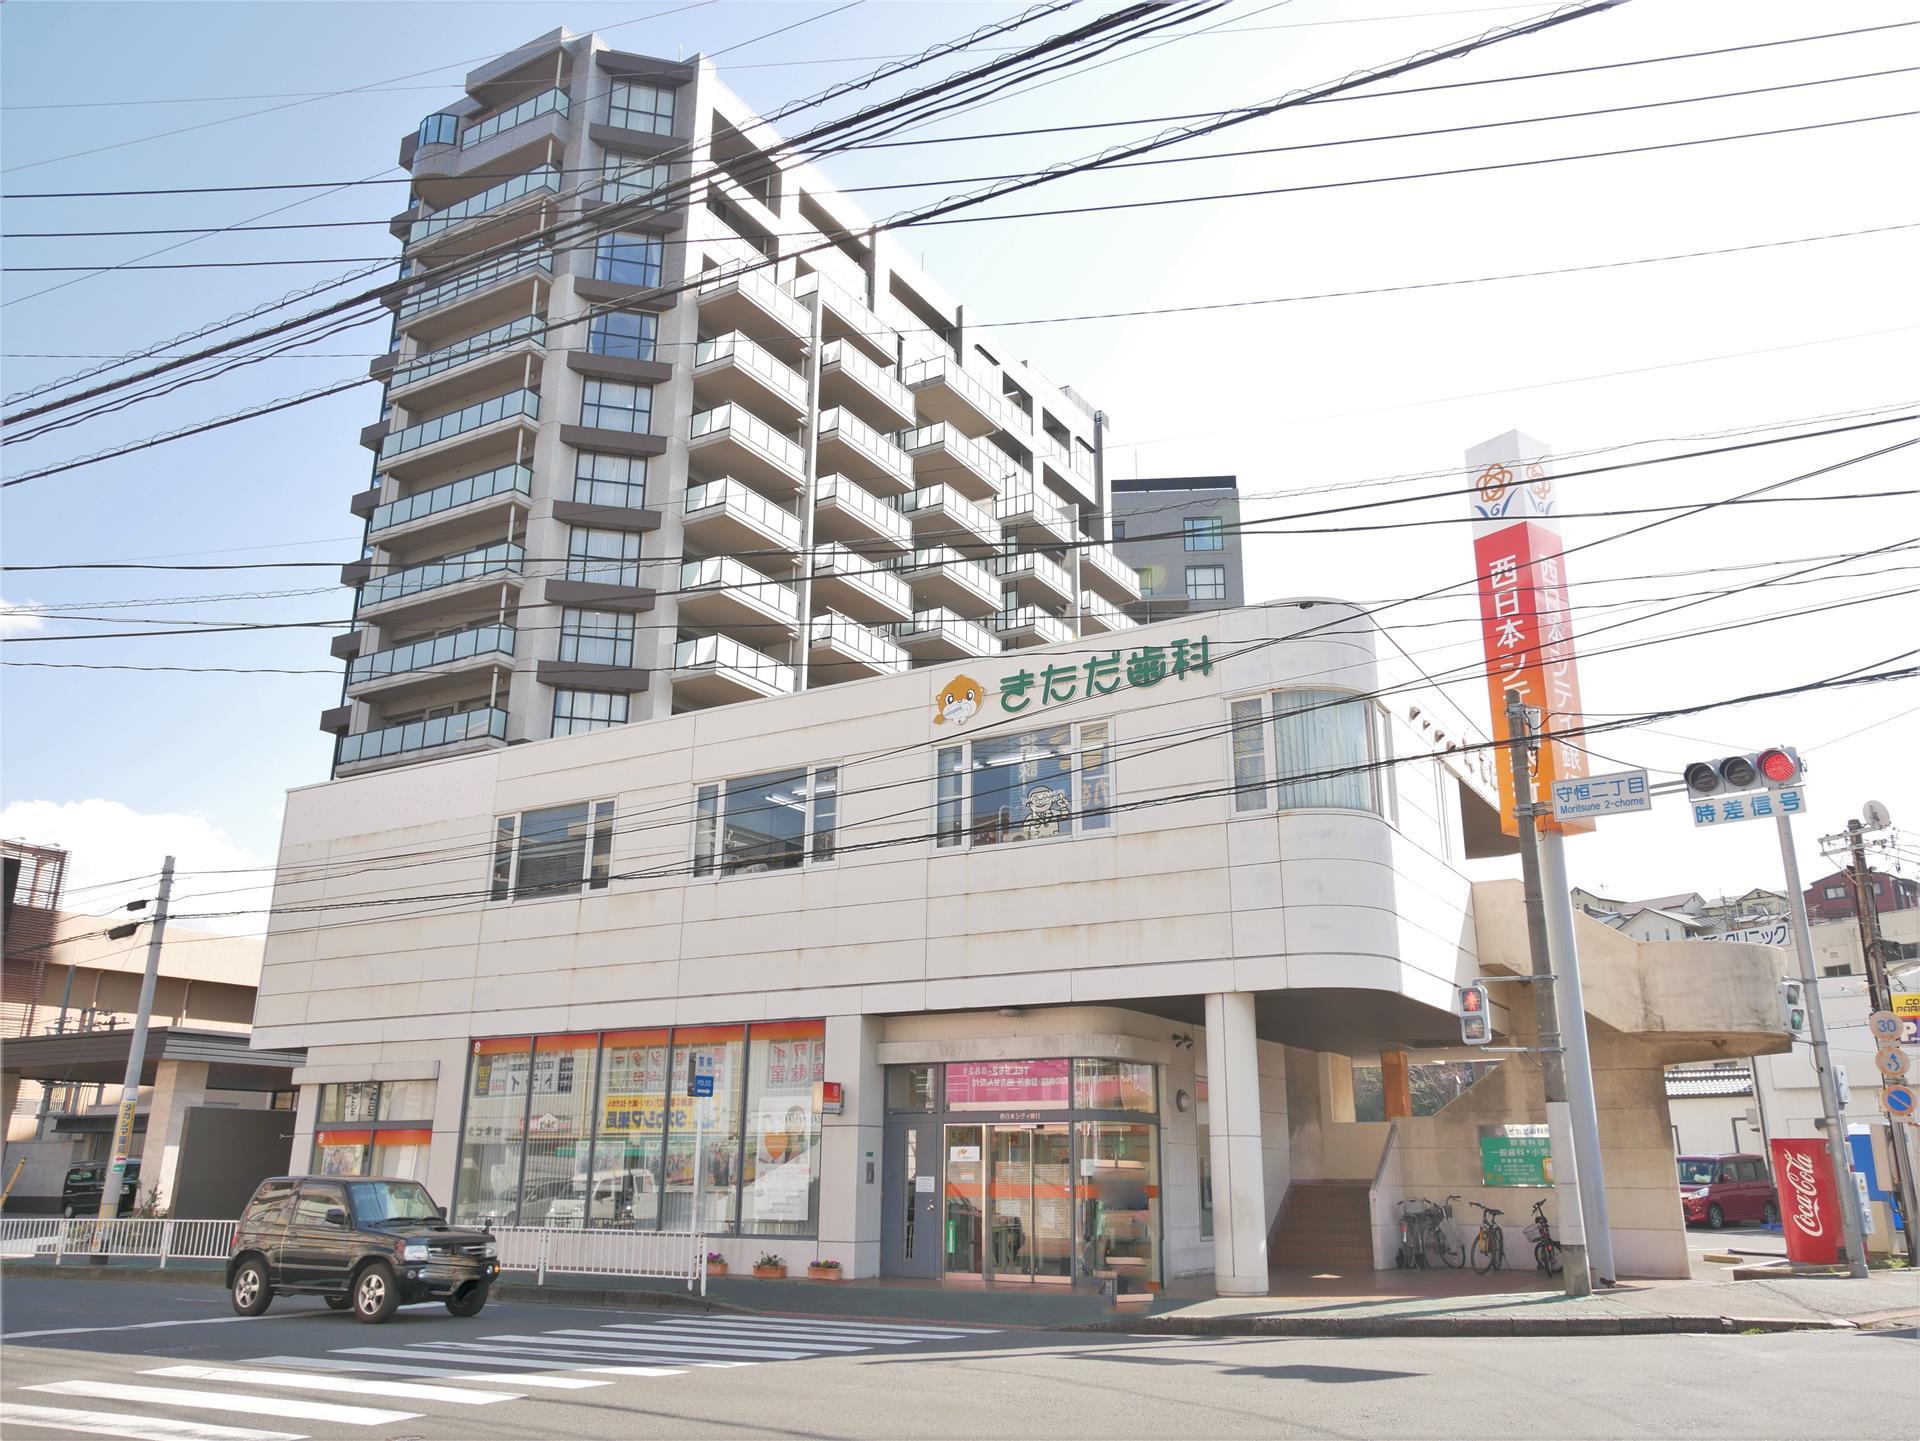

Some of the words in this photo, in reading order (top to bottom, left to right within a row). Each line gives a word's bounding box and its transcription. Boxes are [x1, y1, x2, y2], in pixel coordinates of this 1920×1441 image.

[1000, 635, 1213, 712] きただ歯科
[1556, 777, 1644, 803] 守恒二丁目
[1560, 802, 1601, 815] Moritsune
[1604, 797, 1645, 810] 2-chome
[1695, 791, 1801, 823] 時差信号
[1877, 1019, 1897, 1033] 30
[696, 1079, 712, 1087] POLICE
[1783, 1147, 1824, 1238] Coca-Cola
